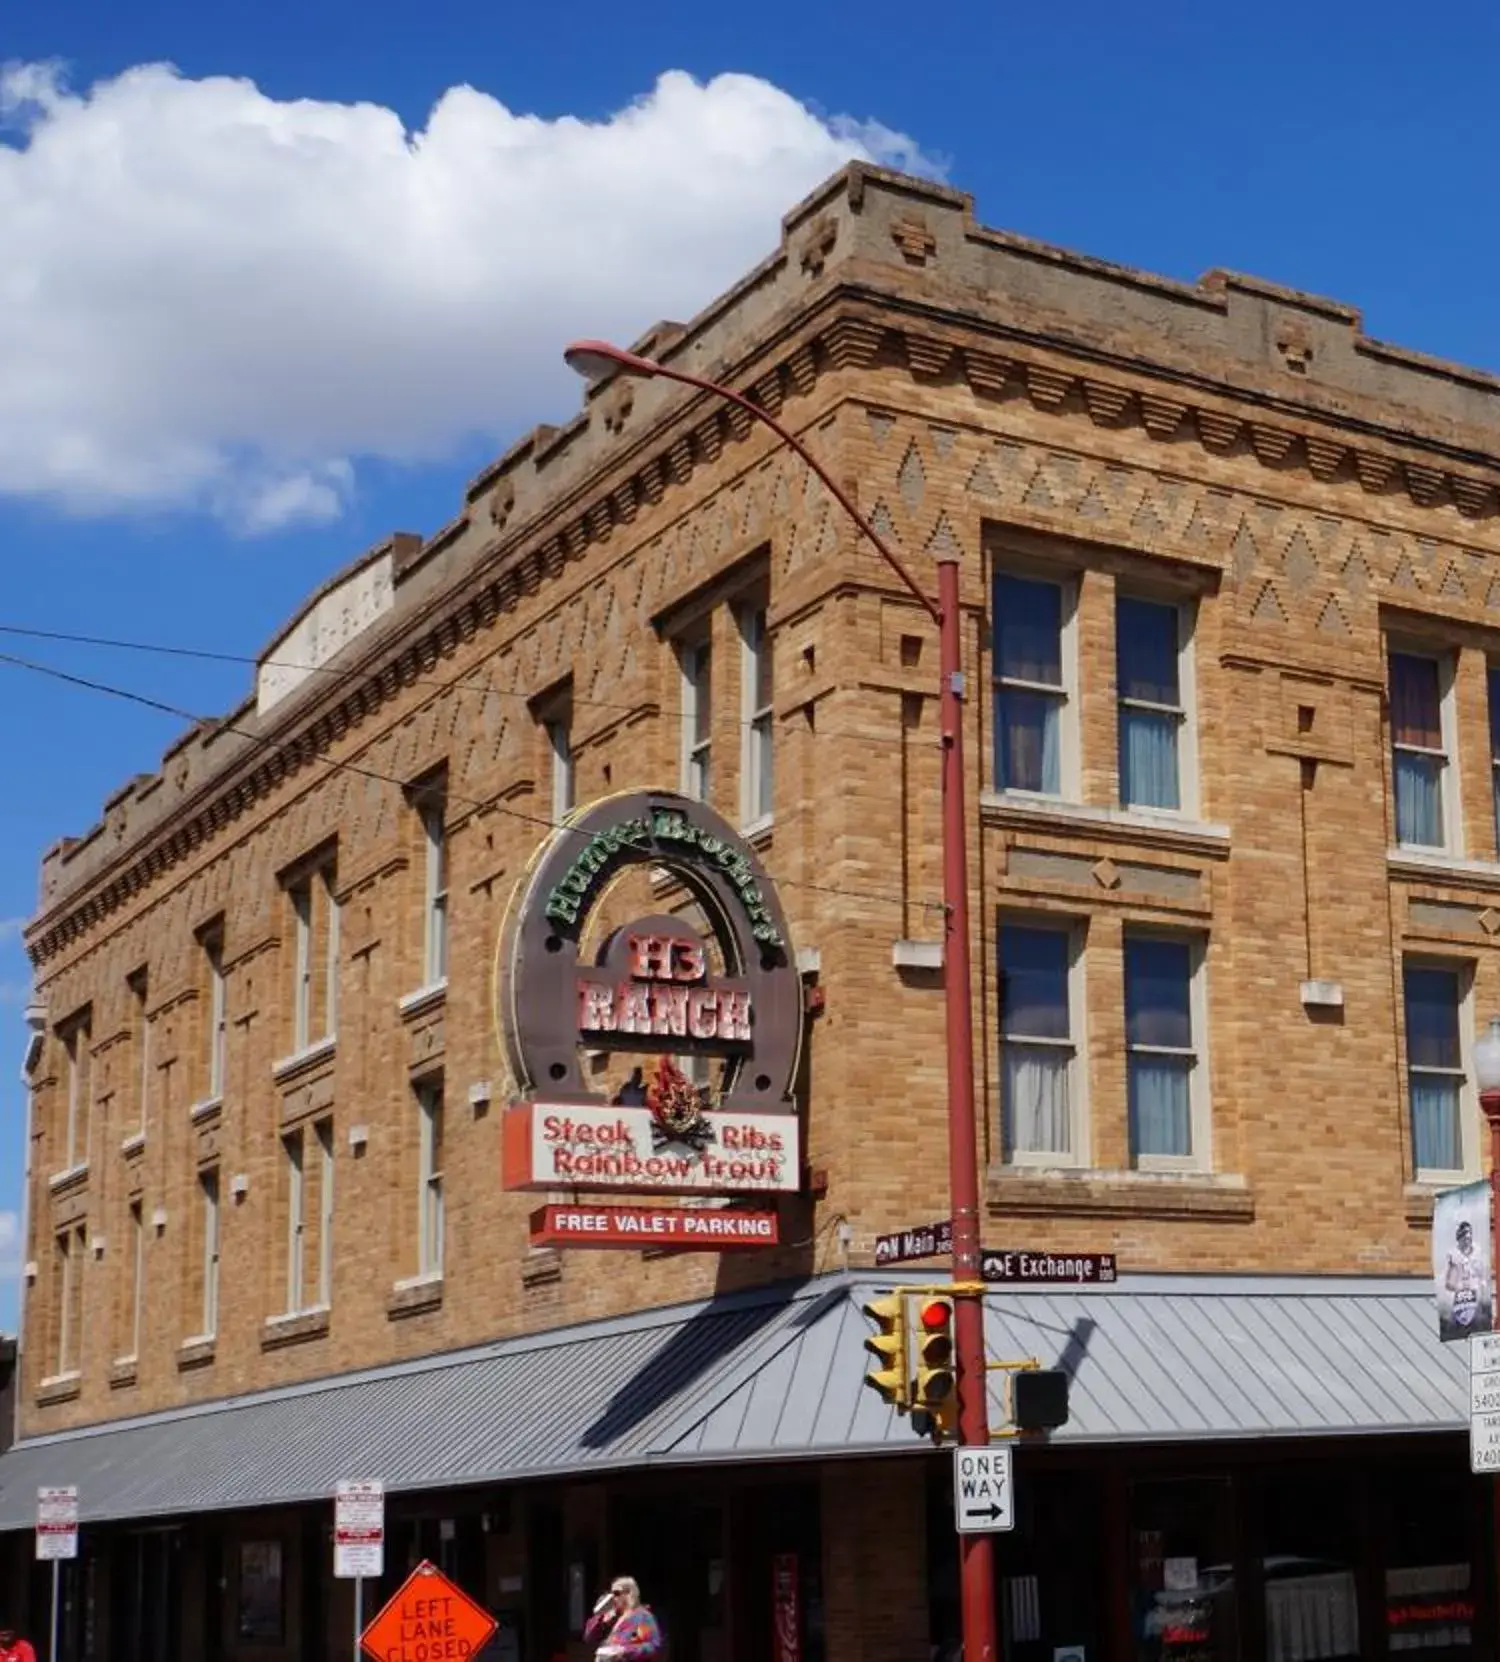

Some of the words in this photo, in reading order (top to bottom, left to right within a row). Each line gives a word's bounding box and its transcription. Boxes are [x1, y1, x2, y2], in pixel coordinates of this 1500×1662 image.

[546, 817, 650, 925] Hunter
[577, 979, 751, 1041] RANCH
[544, 1115, 632, 1145] Steak
[721, 1124, 785, 1151] Ribs
[553, 1147, 690, 1178] Rainbow
[701, 1151, 778, 1179] Trout
[554, 1213, 609, 1231] FREE
[614, 1215, 678, 1233] VALET
[683, 1216, 772, 1236] PARKING
[889, 1236, 899, 1259] N
[904, 1231, 935, 1257] Main
[1005, 1255, 1013, 1276] E
[1020, 1254, 1093, 1282] Exchange
[961, 1455, 1005, 1477] ONE
[961, 1478, 1006, 1498] WAY
[401, 1597, 453, 1620] LEFT
[401, 1618, 456, 1642] LANE
[387, 1638, 472, 1662] CLOSED
